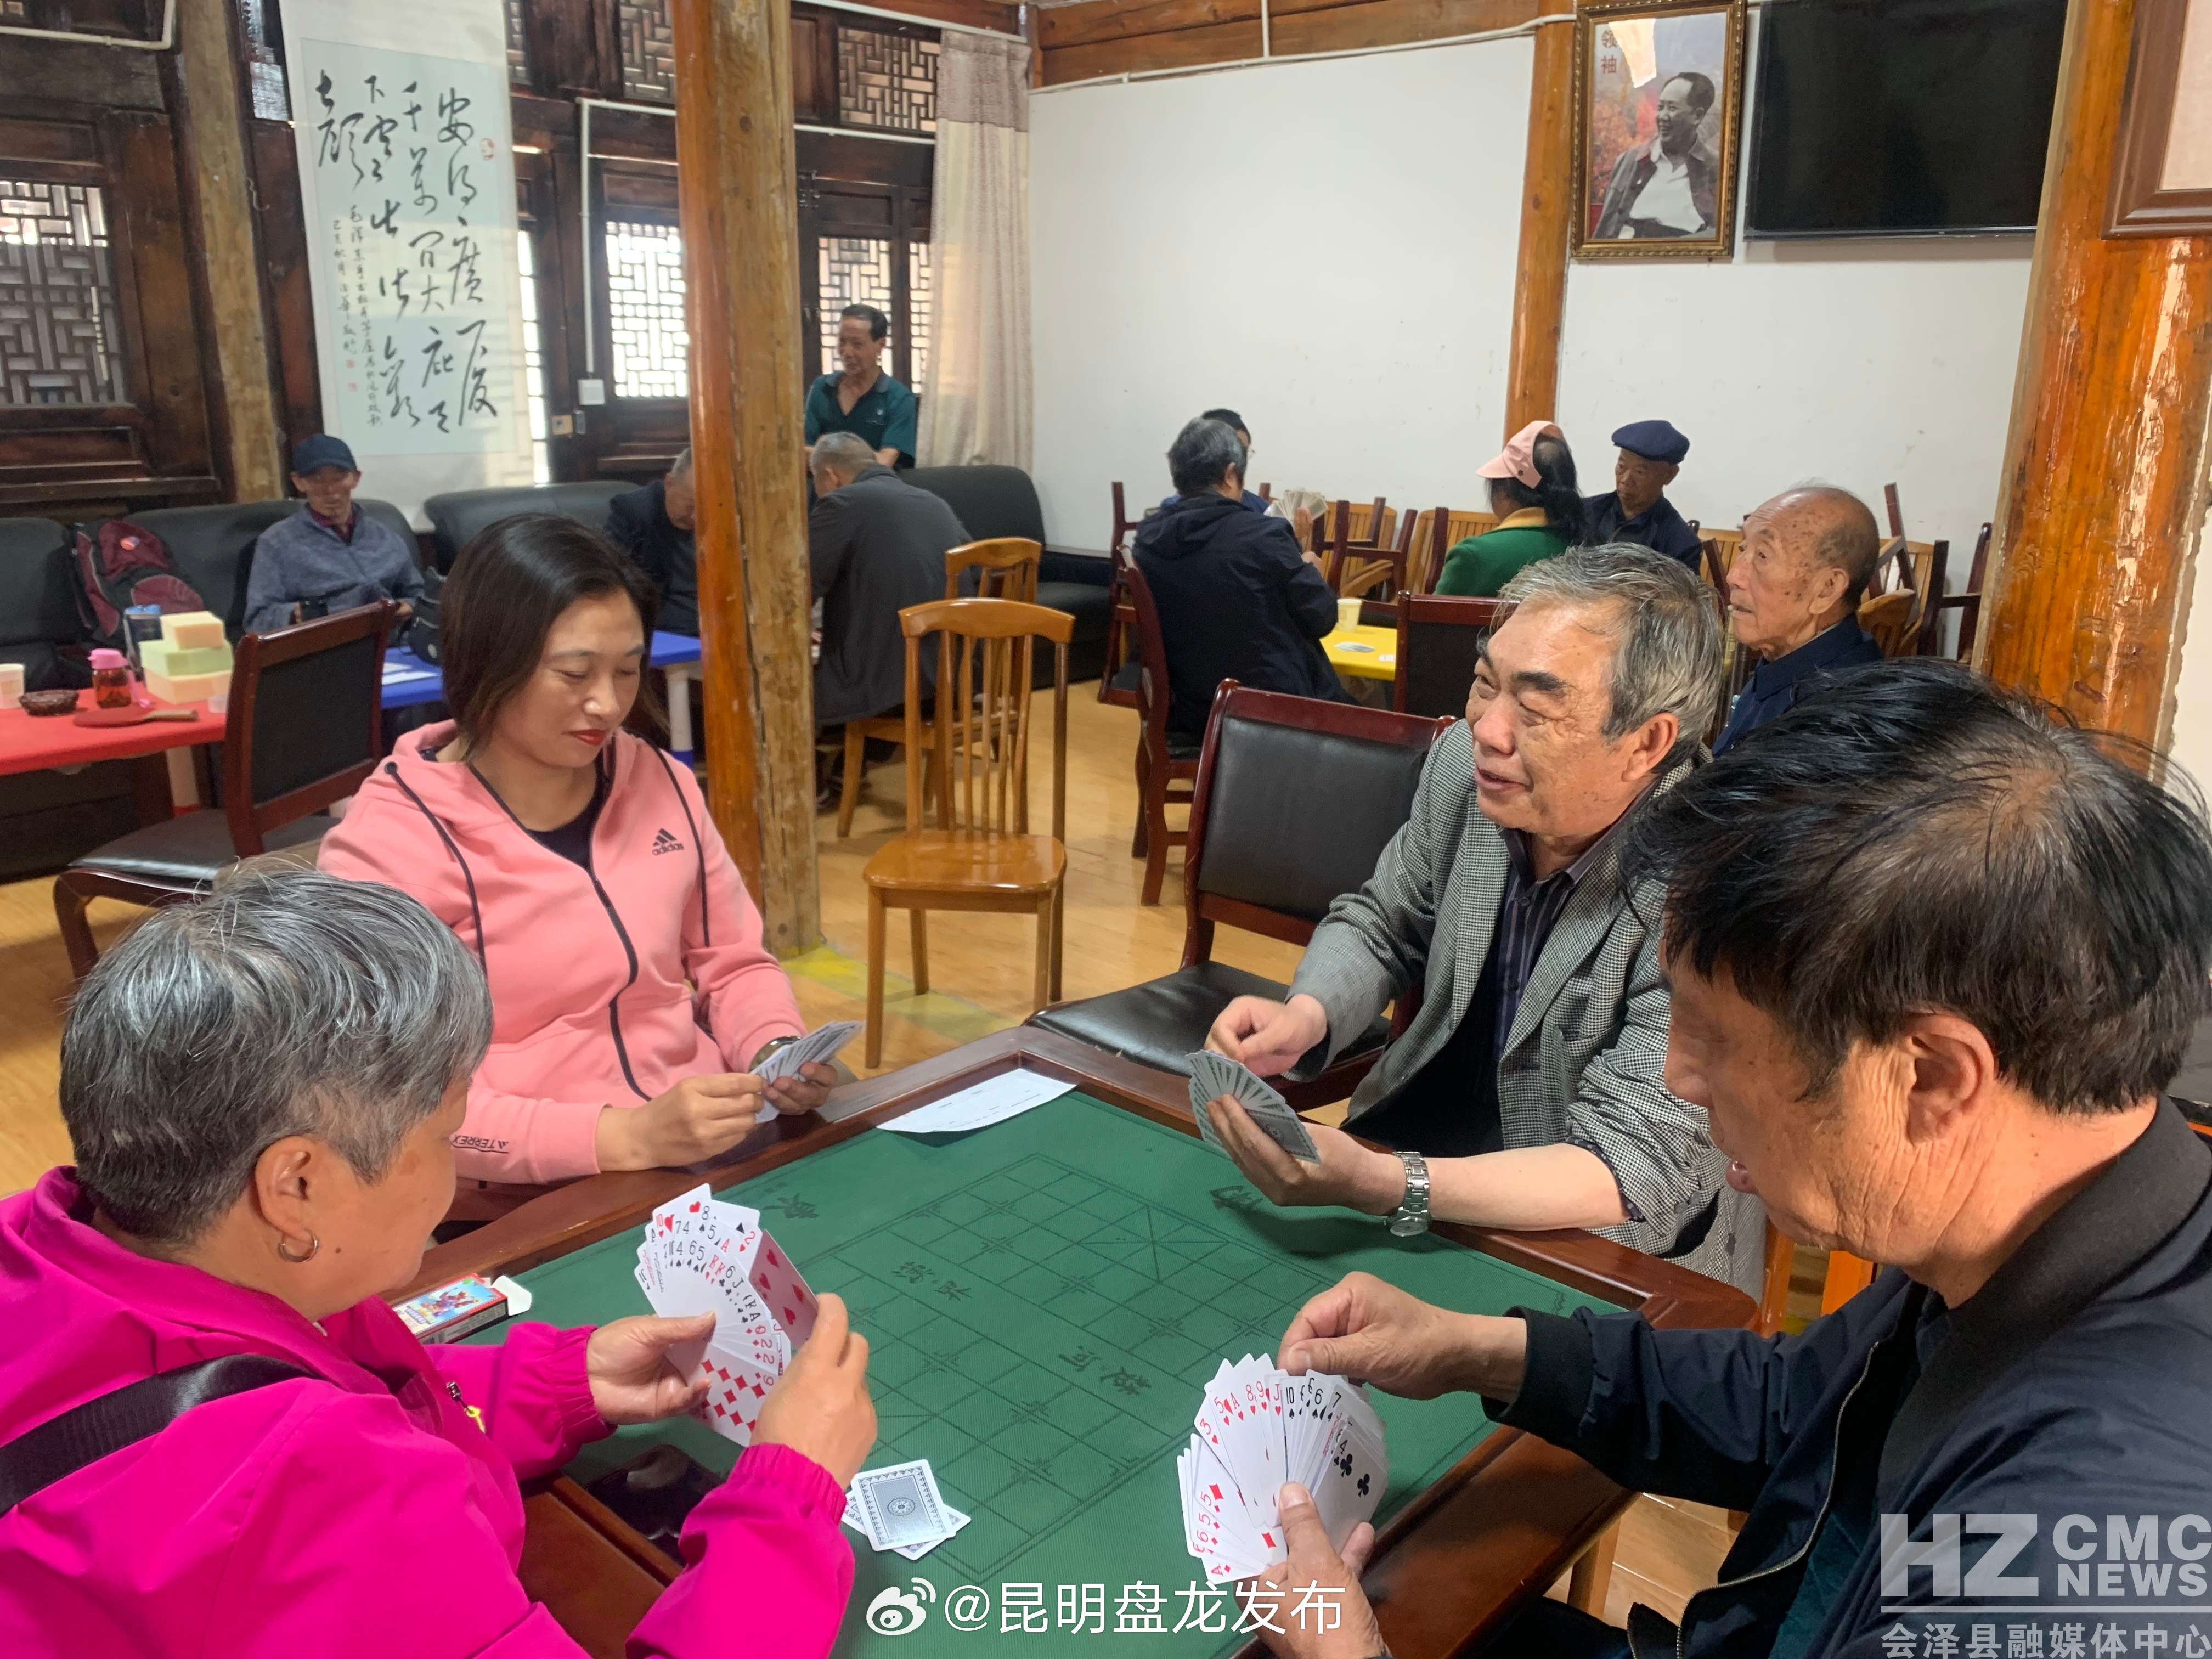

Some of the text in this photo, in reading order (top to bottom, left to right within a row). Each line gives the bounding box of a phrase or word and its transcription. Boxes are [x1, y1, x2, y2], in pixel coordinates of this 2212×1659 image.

[1601, 30, 1618, 74] 领袖
[652, 843, 684, 856] adidas
[453, 1135, 495, 1149] TERREX
[1245, 1384, 1254, 1401] 8
[1256, 1381, 1265, 1398] 9
[1273, 1384, 1280, 1401] J
[1286, 1387, 1295, 1404] 10
[1314, 1388, 1323, 1405] 6
[1214, 1396, 1224, 1414] 5
[1231, 1392, 1240, 1410] A
[1333, 1391, 1342, 1408] 7
[1200, 1418, 1211, 1435] 3
[1339, 1439, 1348, 1455] 4
[1200, 1491, 1212, 1506] 5
[1198, 1512, 1211, 1526] 5
[1196, 1530, 1209, 1543] 6
[1211, 1564, 1224, 1577] A
